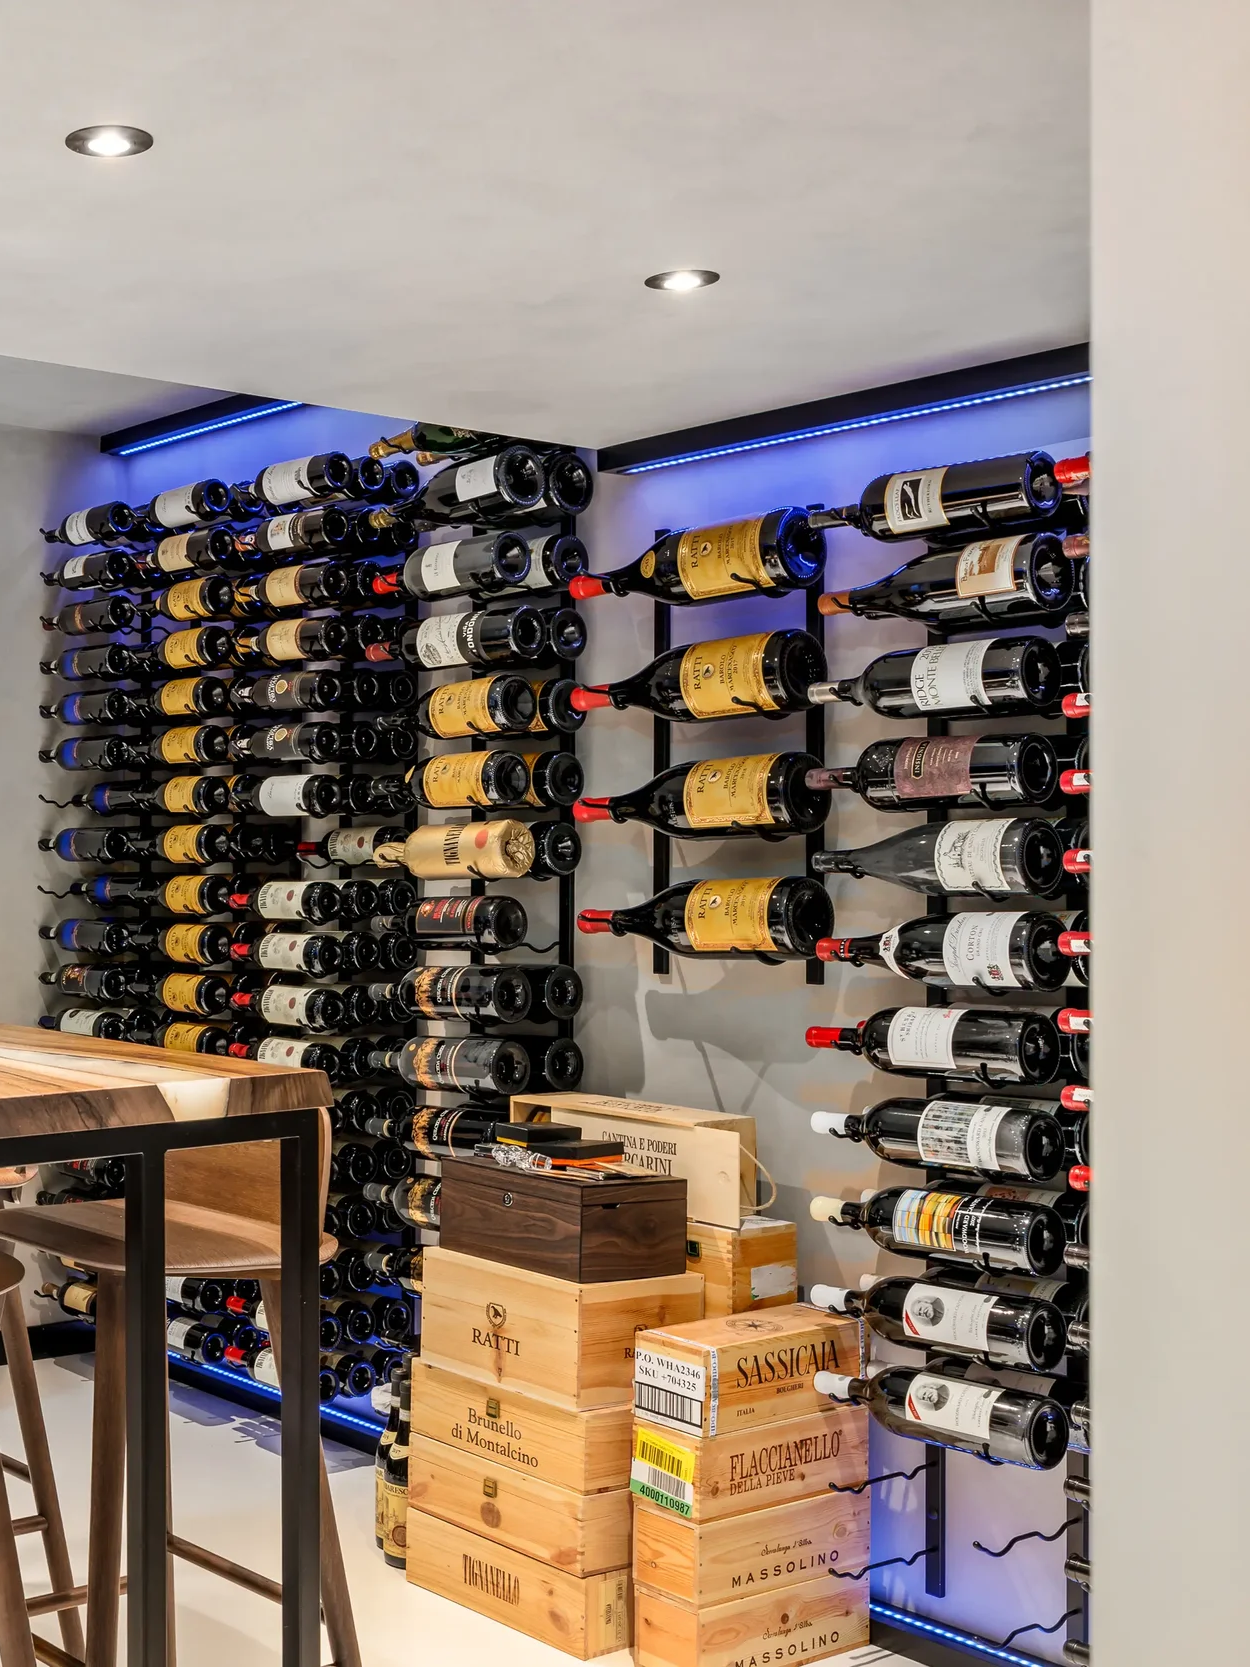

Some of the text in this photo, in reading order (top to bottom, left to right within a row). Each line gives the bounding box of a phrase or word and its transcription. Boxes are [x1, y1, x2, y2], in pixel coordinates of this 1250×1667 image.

[691, 535, 701, 568] RATTI
[693, 656, 703, 690] RATTI
[927, 666, 944, 707] MONTE
[438, 687, 449, 715] RATTI
[915, 674, 931, 707] RIDGE
[433, 756, 446, 783] RATTI
[914, 742, 928, 774] INSIGNIA
[697, 763, 714, 793] RATTI
[723, 762, 736, 789] BAROLO
[698, 887, 713, 919] RATTI
[724, 888, 736, 916] BAROLO
[966, 924, 979, 961] CORTON
[602, 1130, 677, 1156] CANTINA E PODERI
[623, 1152, 672, 1176] RCARINI
[471, 1328, 520, 1356] RATTI
[636, 1351, 654, 1365] P.O.
[656, 1357, 701, 1380] WHA2346
[638, 1365, 697, 1392] SKU +704325
[736, 1340, 840, 1389] SASSICAIA
[776, 1383, 804, 1394] BOLGHERI
[468, 1407, 522, 1441] Brunello
[737, 1408, 755, 1417] ITALIA
[451, 1424, 539, 1468] di Montalcino
[729, 1431, 840, 1482] FLACCIANELLO
[729, 1468, 795, 1496] DELLA PIEVE
[639, 1484, 691, 1517] 4000110987
[463, 1553, 521, 1607] TIGNANELLO
[732, 1550, 839, 1588] MASSOLINO
[734, 1631, 840, 1667] MASSOLINO
